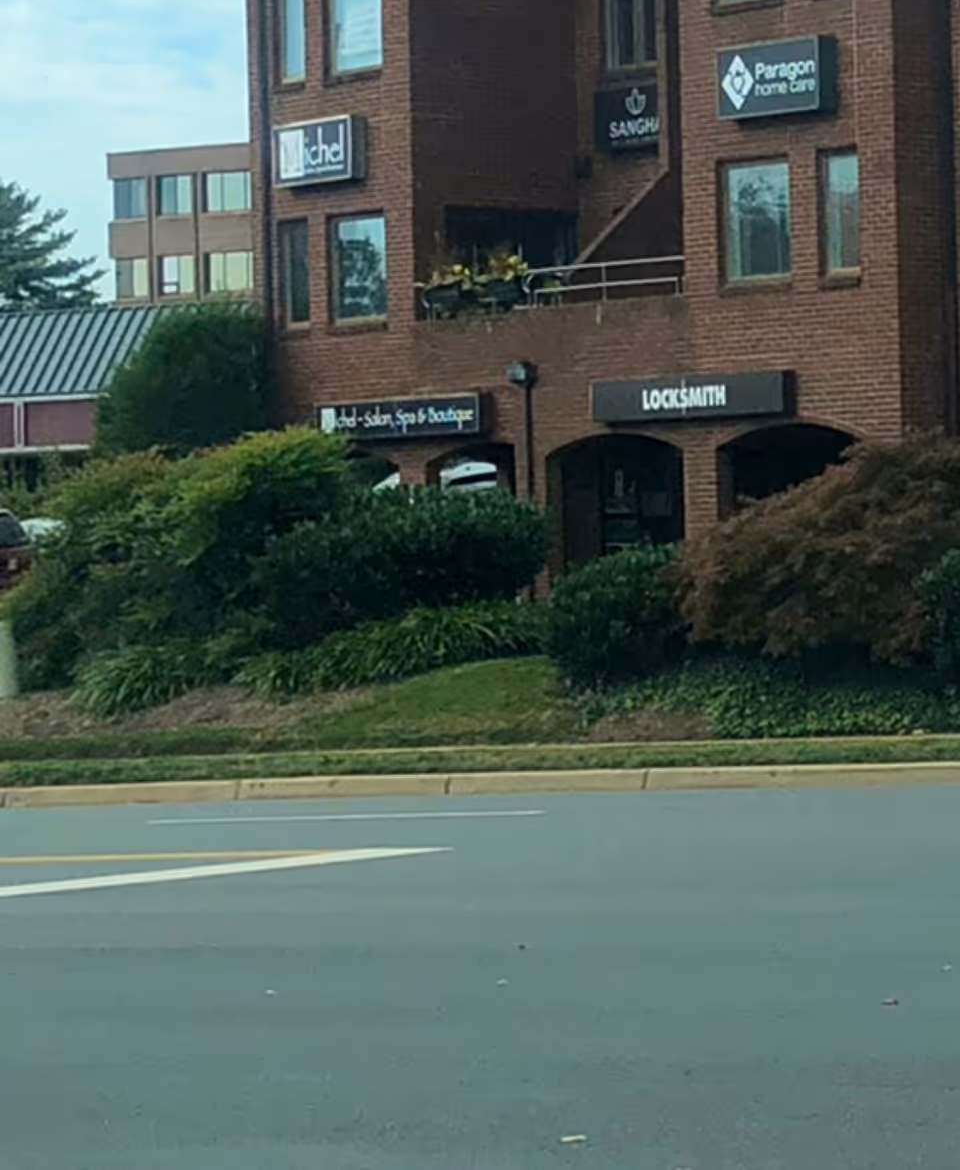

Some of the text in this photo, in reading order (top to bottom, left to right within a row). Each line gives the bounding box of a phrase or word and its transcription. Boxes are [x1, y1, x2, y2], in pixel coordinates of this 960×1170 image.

[755, 60, 816, 80] Paragon
[755, 78, 816, 97] home care
[642, 384, 727, 410] LOCKSMITH
